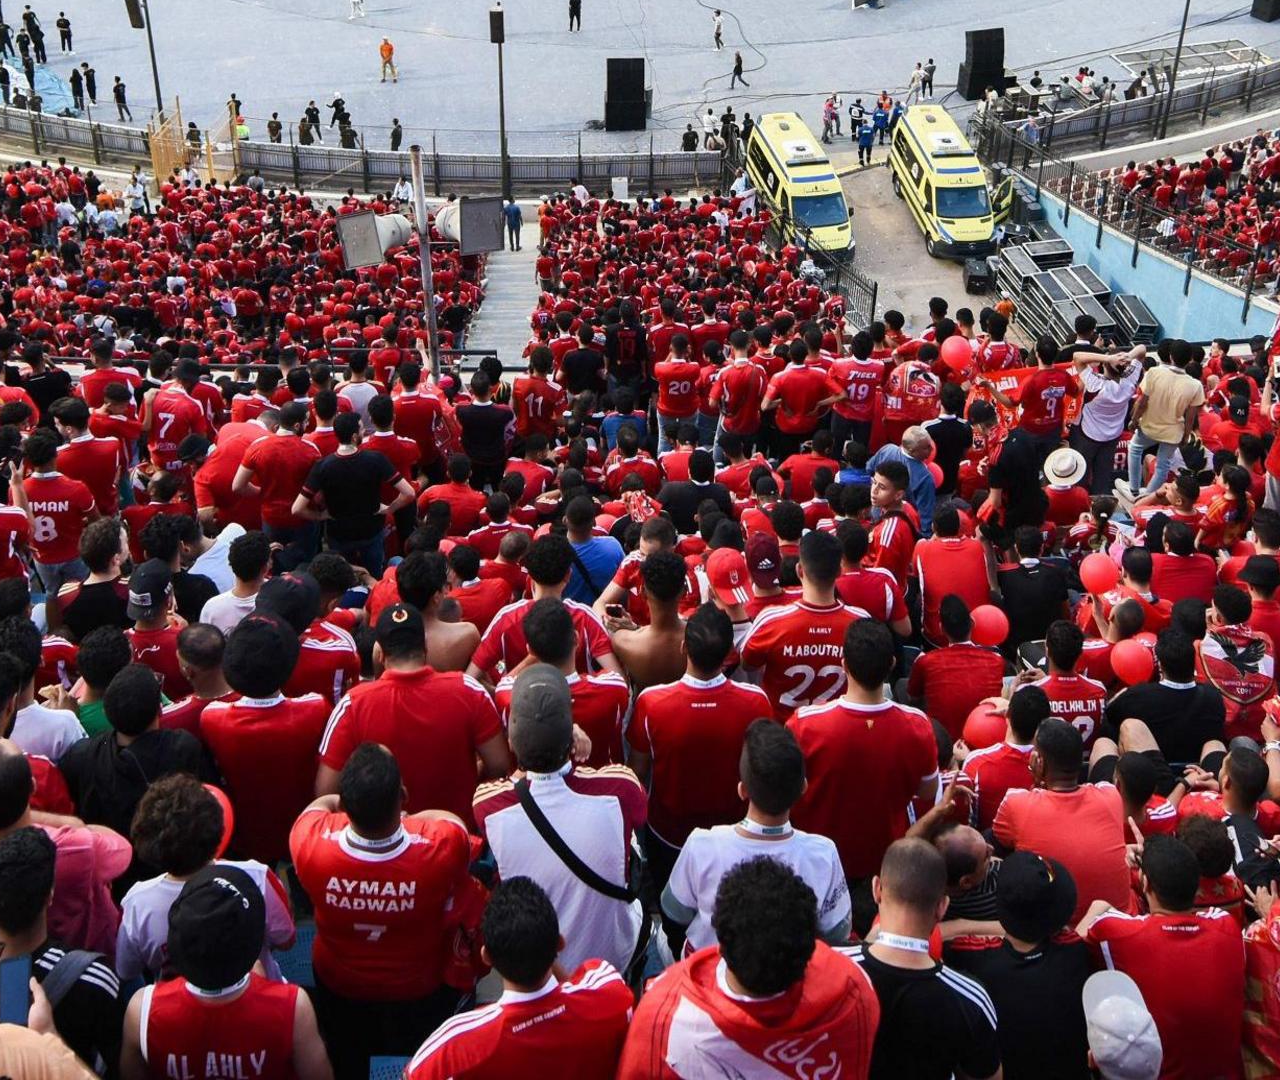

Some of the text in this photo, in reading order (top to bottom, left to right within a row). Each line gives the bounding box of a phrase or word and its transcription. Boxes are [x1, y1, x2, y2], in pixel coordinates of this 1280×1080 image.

[669, 380, 691, 395] 20
[847, 384, 870, 402] 19
[524, 392, 544, 418] 11
[158, 412, 176, 440] 7
[33, 515, 57, 542] 8
[783, 644, 845, 658] M.ABOUTRI
[778, 663, 848, 708] 22
[326, 876, 416, 897] AYMAN
[325, 894, 415, 913] RADWAN
[353, 923, 387, 942] 7
[512, 1021, 527, 1033] CLUB
[533, 1015, 544, 1025] THE
[544, 1004, 566, 1022] CENTURY
[166, 1049, 267, 1080] AL AHLY
